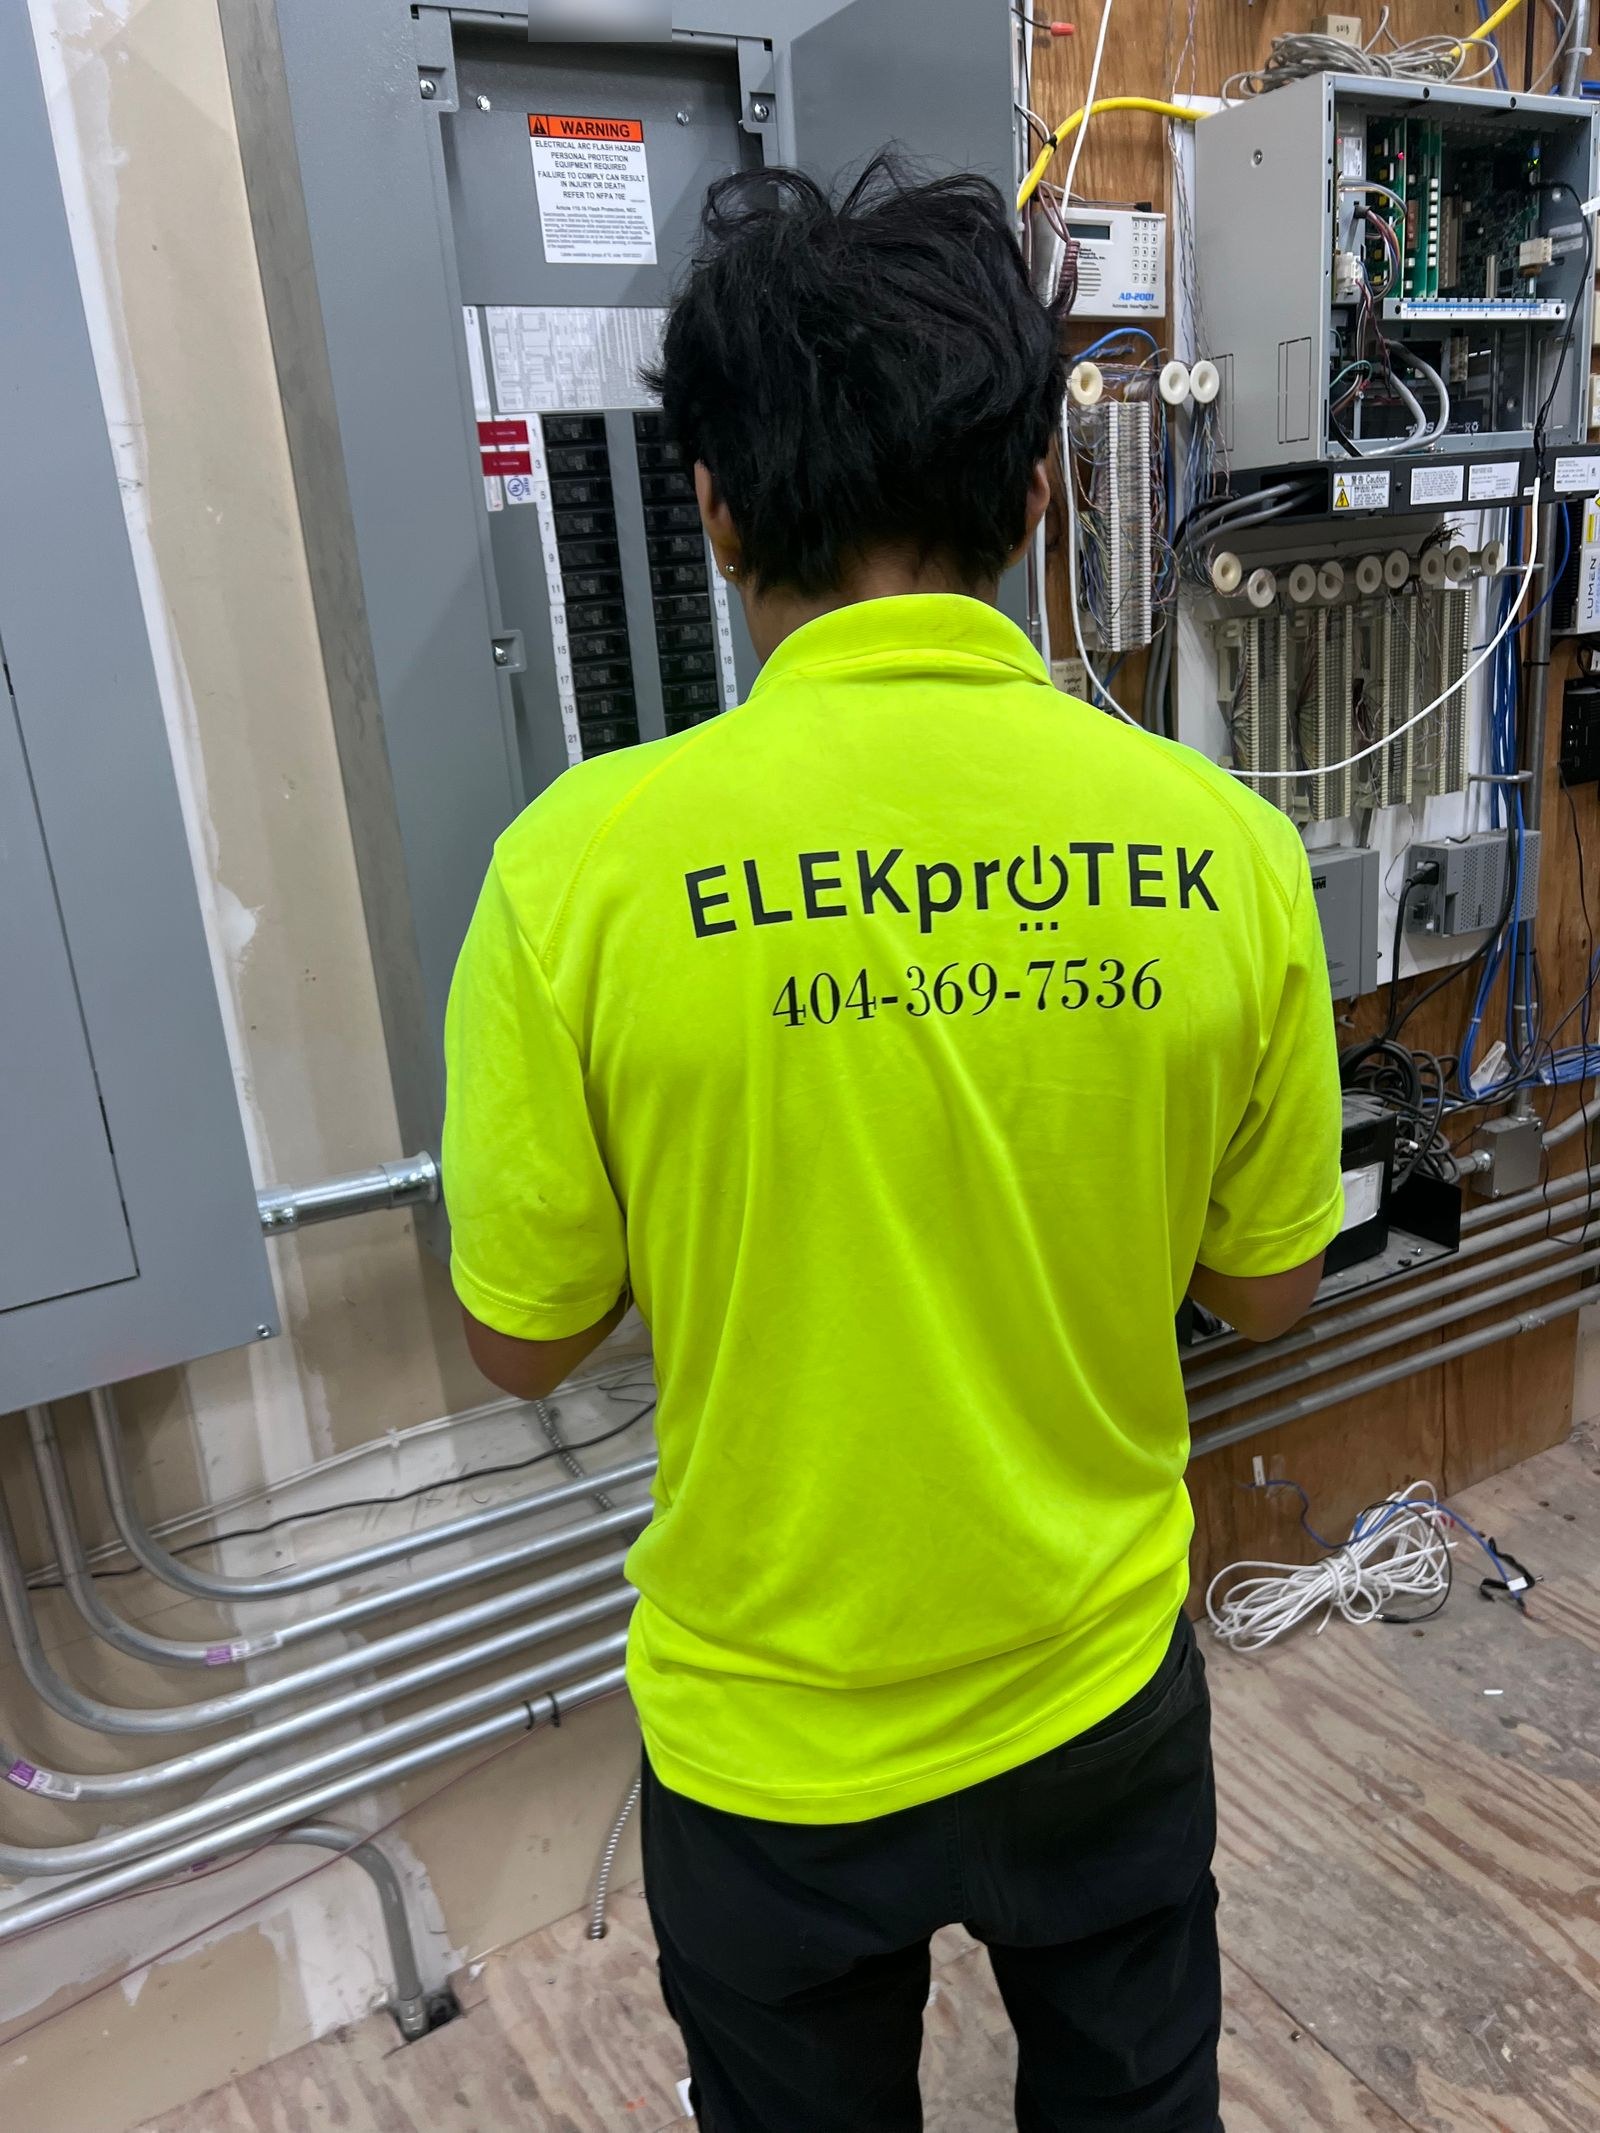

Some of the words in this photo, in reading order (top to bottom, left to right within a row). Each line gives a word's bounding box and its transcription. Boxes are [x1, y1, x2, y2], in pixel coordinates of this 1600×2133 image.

[560, 120, 630, 138] WARNING
[535, 140, 575, 149] ELECTRICAL
[578, 142, 591, 150] ARC
[592, 143, 613, 151] FLASH
[614, 144, 641, 152] HAZARD
[550, 152, 586, 160] PERSONAL
[588, 153, 628, 162] PROTECTION
[555, 161, 592, 170] EQUIPMENT
[594, 162, 626, 171] REQUIRED
[538, 170, 566, 179] FAILURE
[567, 171, 576, 179] TO
[578, 172, 604, 180] COMPLY
[621, 174, 645, 182] RESULT
[569, 180, 592, 188] INJURY
[604, 182, 626, 190] DEATH
[563, 191, 586, 199] REFER
[551, 584, 560, 594] 11
[1586, 558, 1596, 620] LUMEN
[717, 599, 726, 608] 14
[554, 614, 564, 625] 13
[720, 628, 730, 636] 16
[557, 645, 567, 656] 15
[724, 656, 732, 664] 18
[560, 675, 570, 684] 17
[726, 684, 736, 694] 20
[564, 704, 574, 714] 19
[568, 734, 578, 744] 21
[772, 957, 1163, 1028] 404-369-7536
